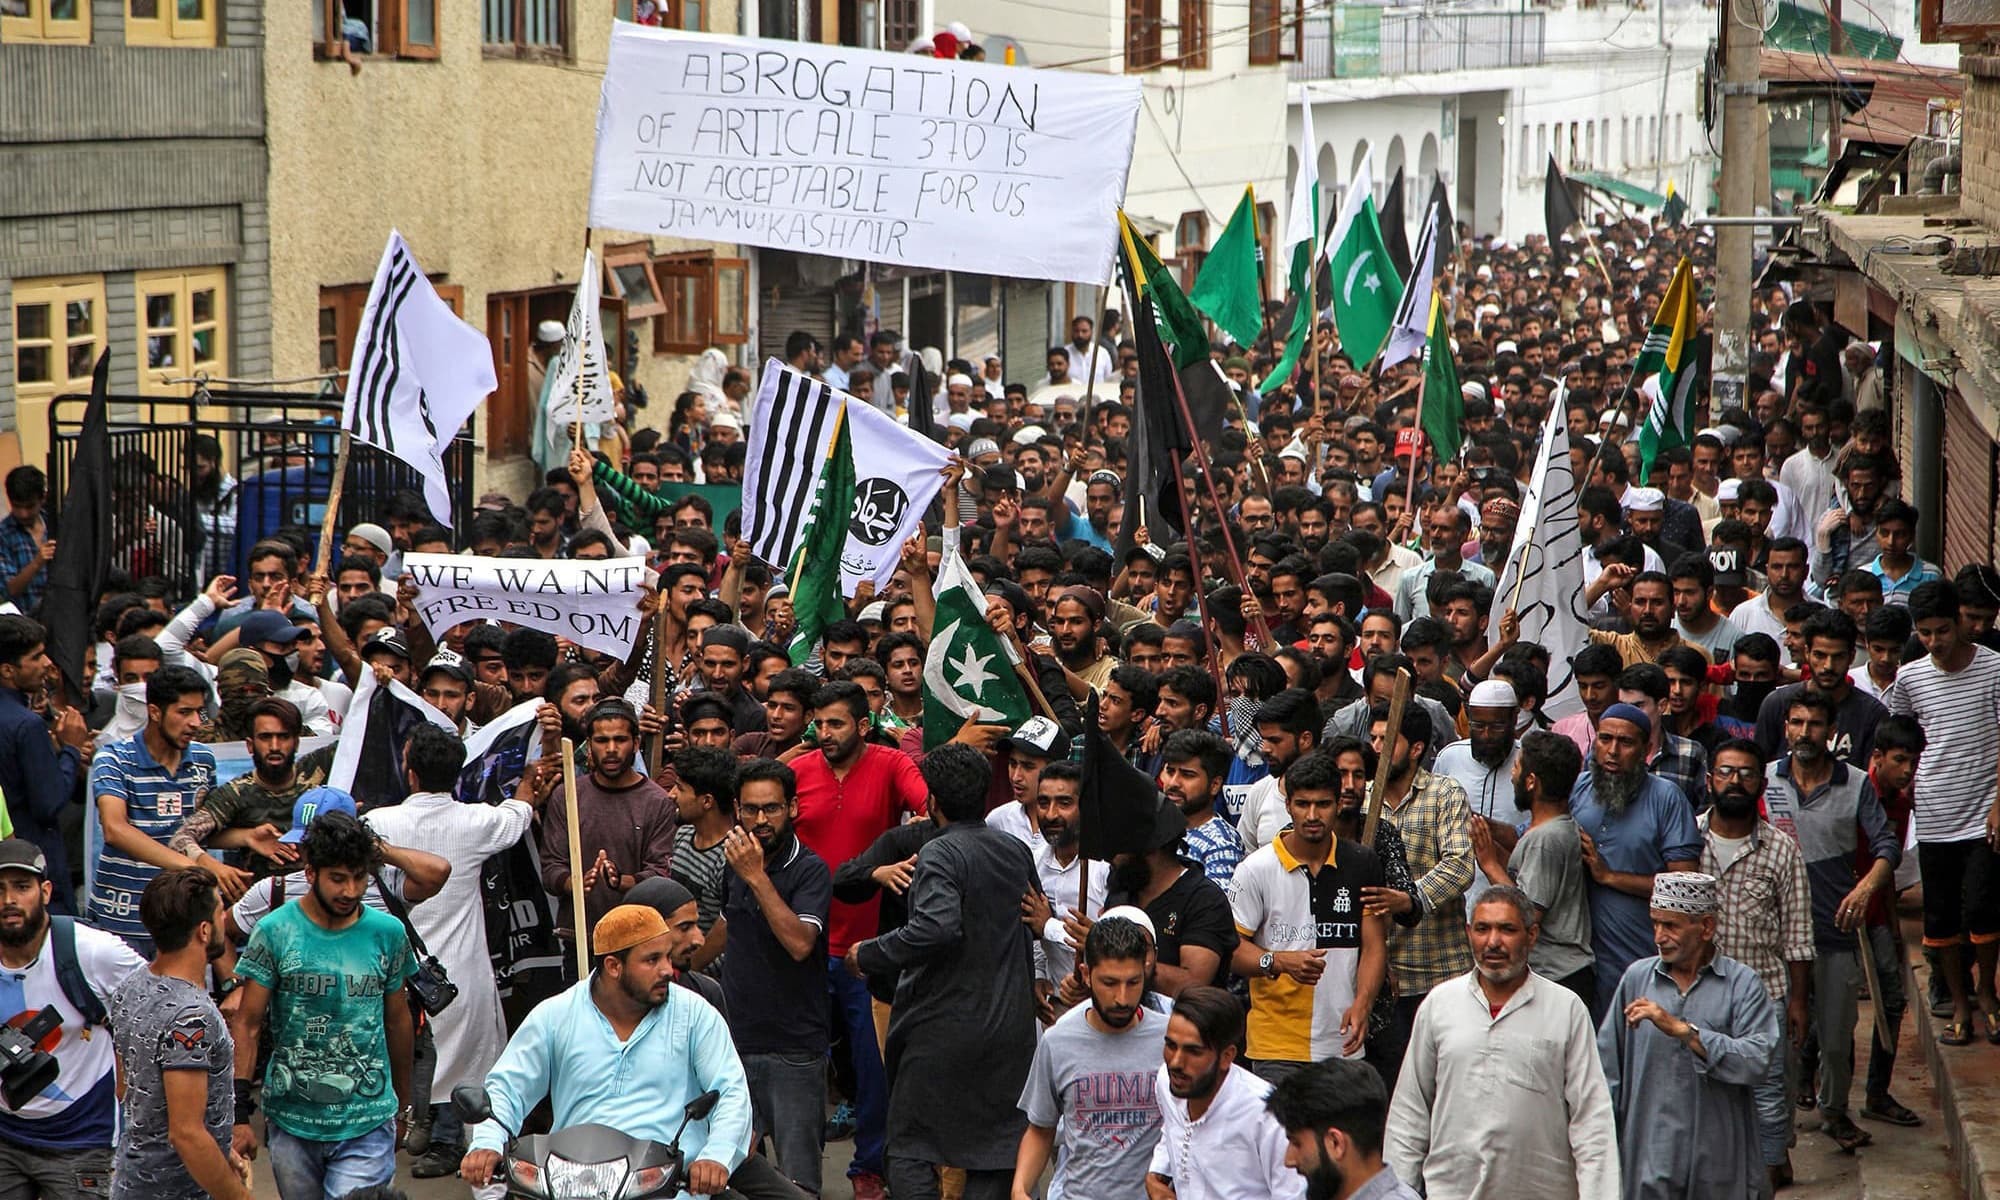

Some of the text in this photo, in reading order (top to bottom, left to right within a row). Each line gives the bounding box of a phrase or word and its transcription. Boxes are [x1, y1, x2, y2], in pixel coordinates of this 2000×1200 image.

[637, 112, 676, 148] OF
[692, 108, 891, 160] ARTICALE
[917, 119, 987, 162] 370
[634, 160, 1031, 218] NOT ACCEPTABLE FOR US
[407, 564, 639, 595] WE WANT
[1271, 922, 1358, 942] HACKETT
[280, 973, 337, 996] STOP
[1092, 1111, 1146, 1125] NINETEEN
